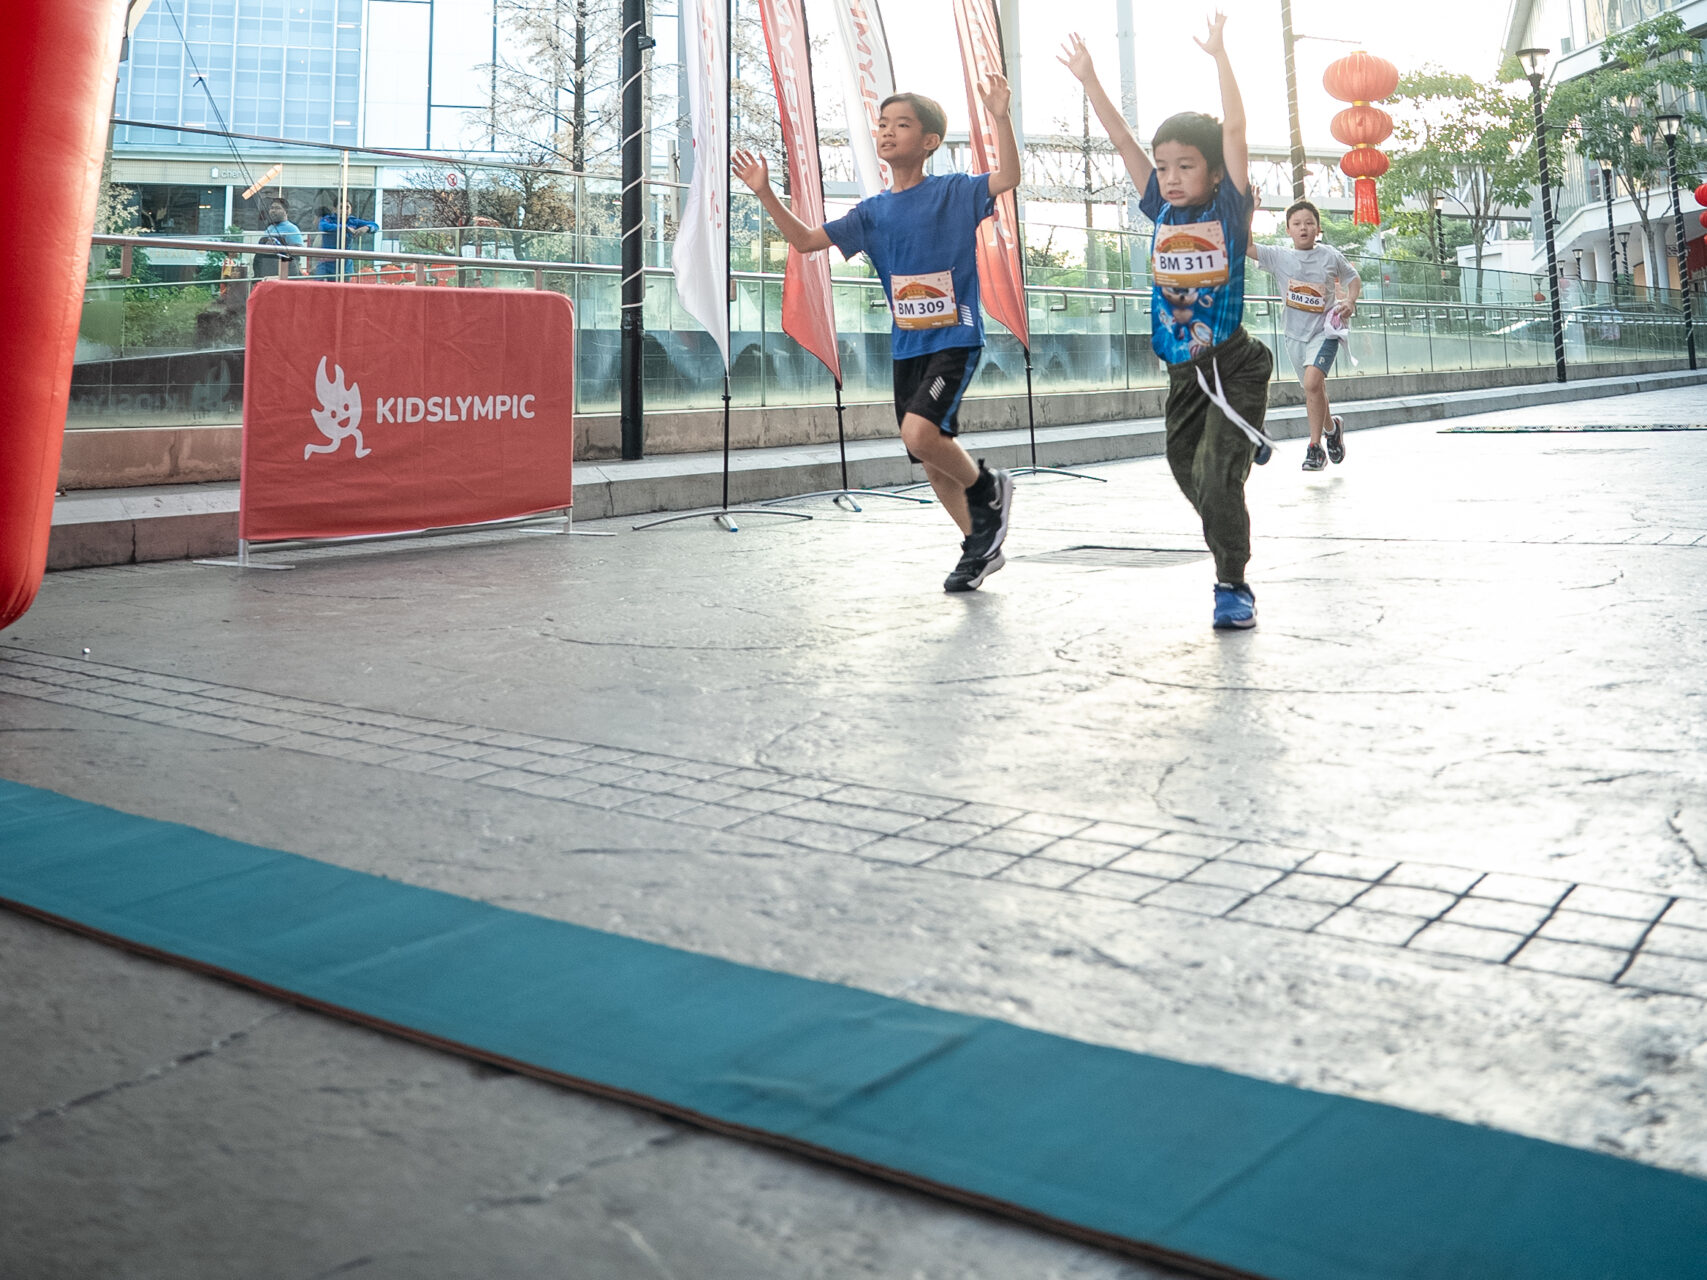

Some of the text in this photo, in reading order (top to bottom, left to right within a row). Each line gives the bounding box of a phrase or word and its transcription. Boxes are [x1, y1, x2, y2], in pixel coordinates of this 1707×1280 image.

[1160, 254, 1213, 270] BM 311
[1291, 293, 1320, 305] BM 266
[898, 300, 944, 315] BM 309
[376, 394, 536, 424] KIDSLYMPIC
